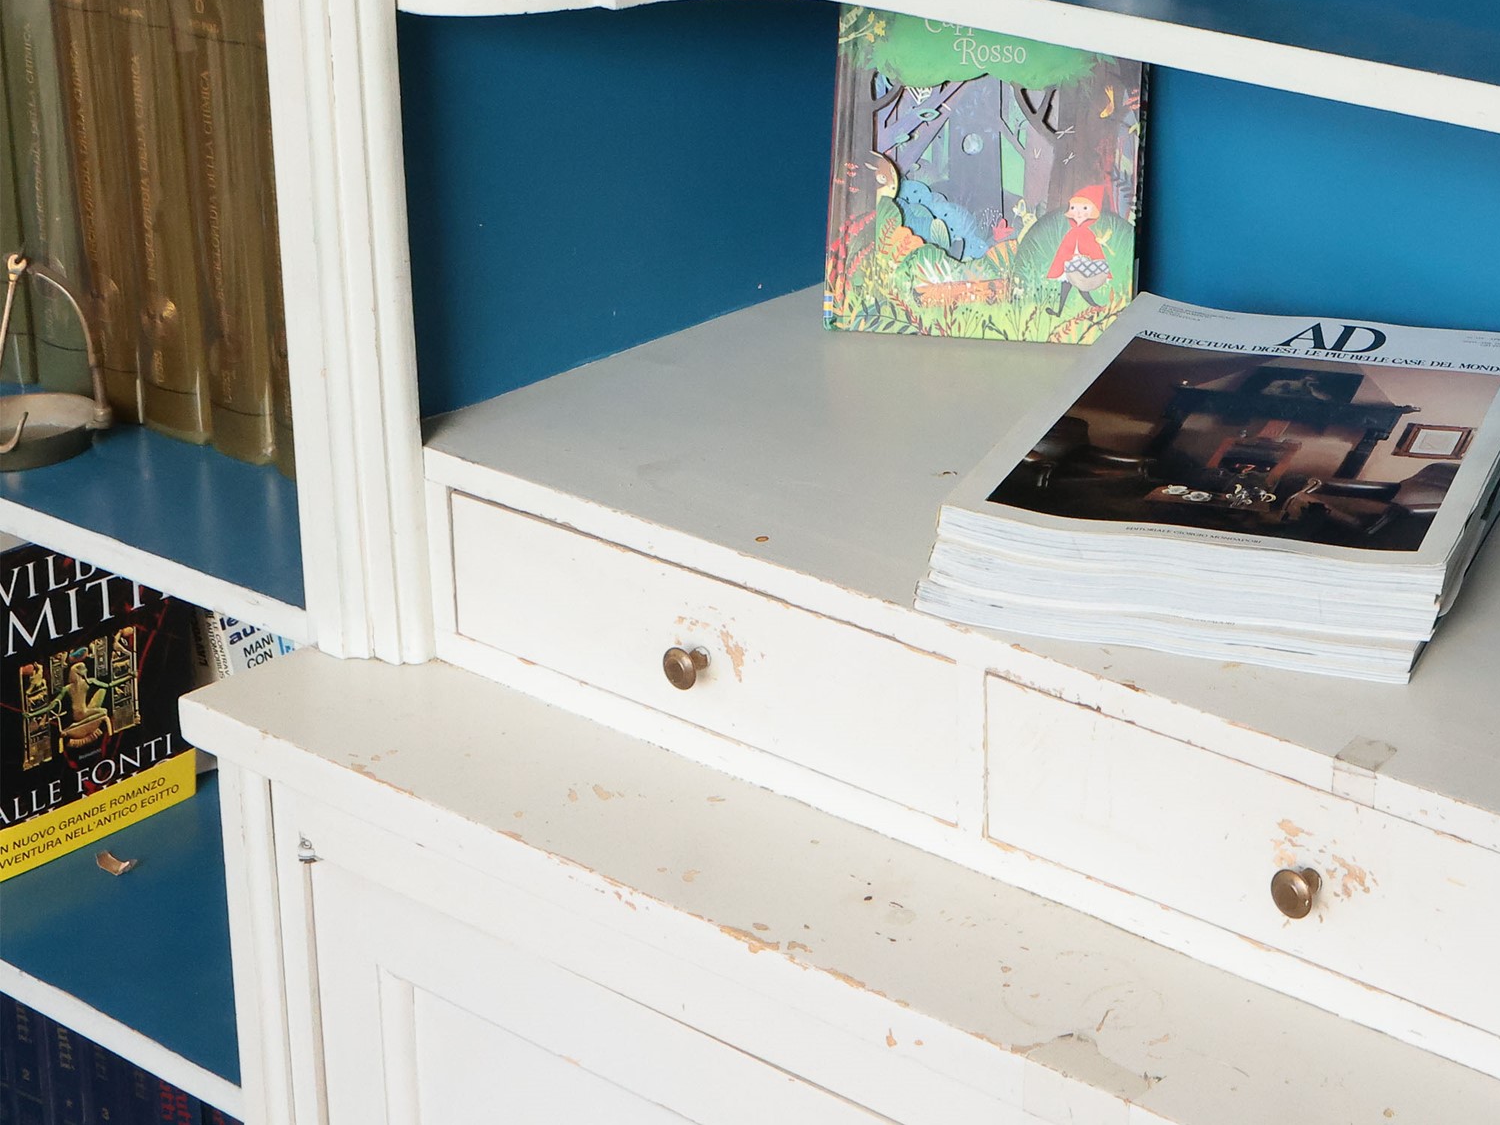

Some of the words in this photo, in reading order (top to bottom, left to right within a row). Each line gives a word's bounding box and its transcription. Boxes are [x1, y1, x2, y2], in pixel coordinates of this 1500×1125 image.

[953, 38, 1027, 69] Rosso
[1136, 329, 1247, 351] ARCHITECTURAL
[1304, 349, 1321, 358] LE
[1349, 353, 1389, 364] BELLE
[1391, 357, 1427, 367] CASE
[1430, 360, 1456, 369] DEL
[1276, 322, 1387, 353] AD
[77, 733, 173, 793] FONTI
[13, 826, 55, 847] NUOVO
[59, 803, 107, 830] GRANDE
[109, 777, 166, 809] ROMANZO
[65, 803, 138, 842] NELL'ANTICO
[141, 784, 180, 808] EGITTO
